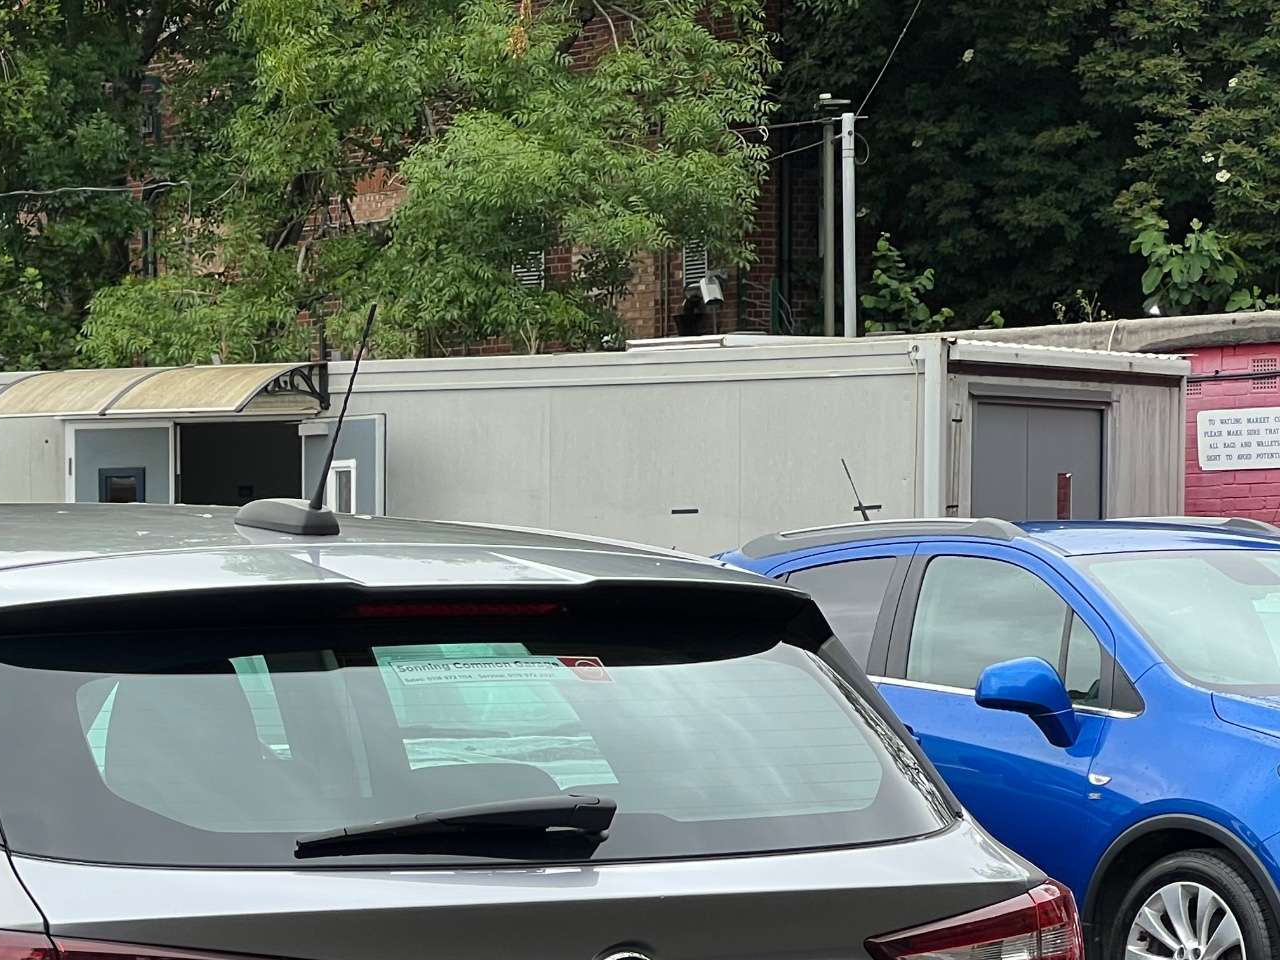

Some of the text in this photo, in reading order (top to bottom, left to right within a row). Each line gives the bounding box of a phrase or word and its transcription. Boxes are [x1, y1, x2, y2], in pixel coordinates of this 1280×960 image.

[1226, 429, 1243, 437] MAKE
[397, 660, 560, 673] Sonning Common Garage
